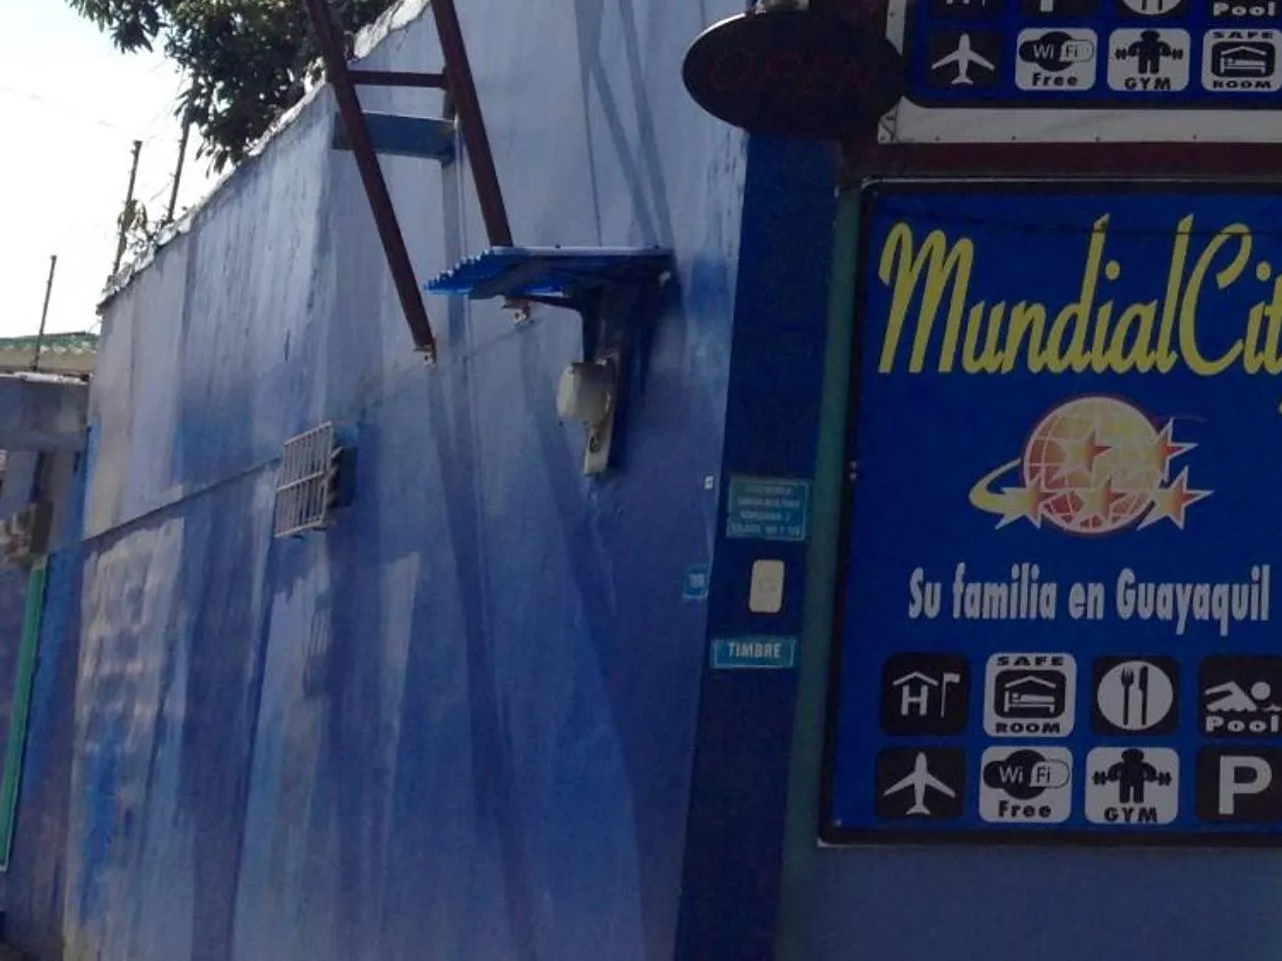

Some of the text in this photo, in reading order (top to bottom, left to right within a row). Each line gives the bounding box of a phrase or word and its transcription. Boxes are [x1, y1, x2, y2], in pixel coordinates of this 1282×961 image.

[1212, 1, 1276, 17] Pool
[1212, 31, 1273, 39] SAFE
[1031, 72, 1078, 86] Free
[1124, 77, 1171, 90] GYM
[1212, 80, 1272, 89] ROOM
[908, 561, 1270, 637] Su familia en Guayaquil
[728, 642, 782, 659] TIMBRE
[997, 656, 1064, 667] SAFE
[995, 722, 1061, 735] ROOM
[1205, 714, 1279, 733] Pool
[1218, 755, 1273, 815] P
[998, 799, 1052, 819] Free
[1104, 806, 1158, 824] GYM
